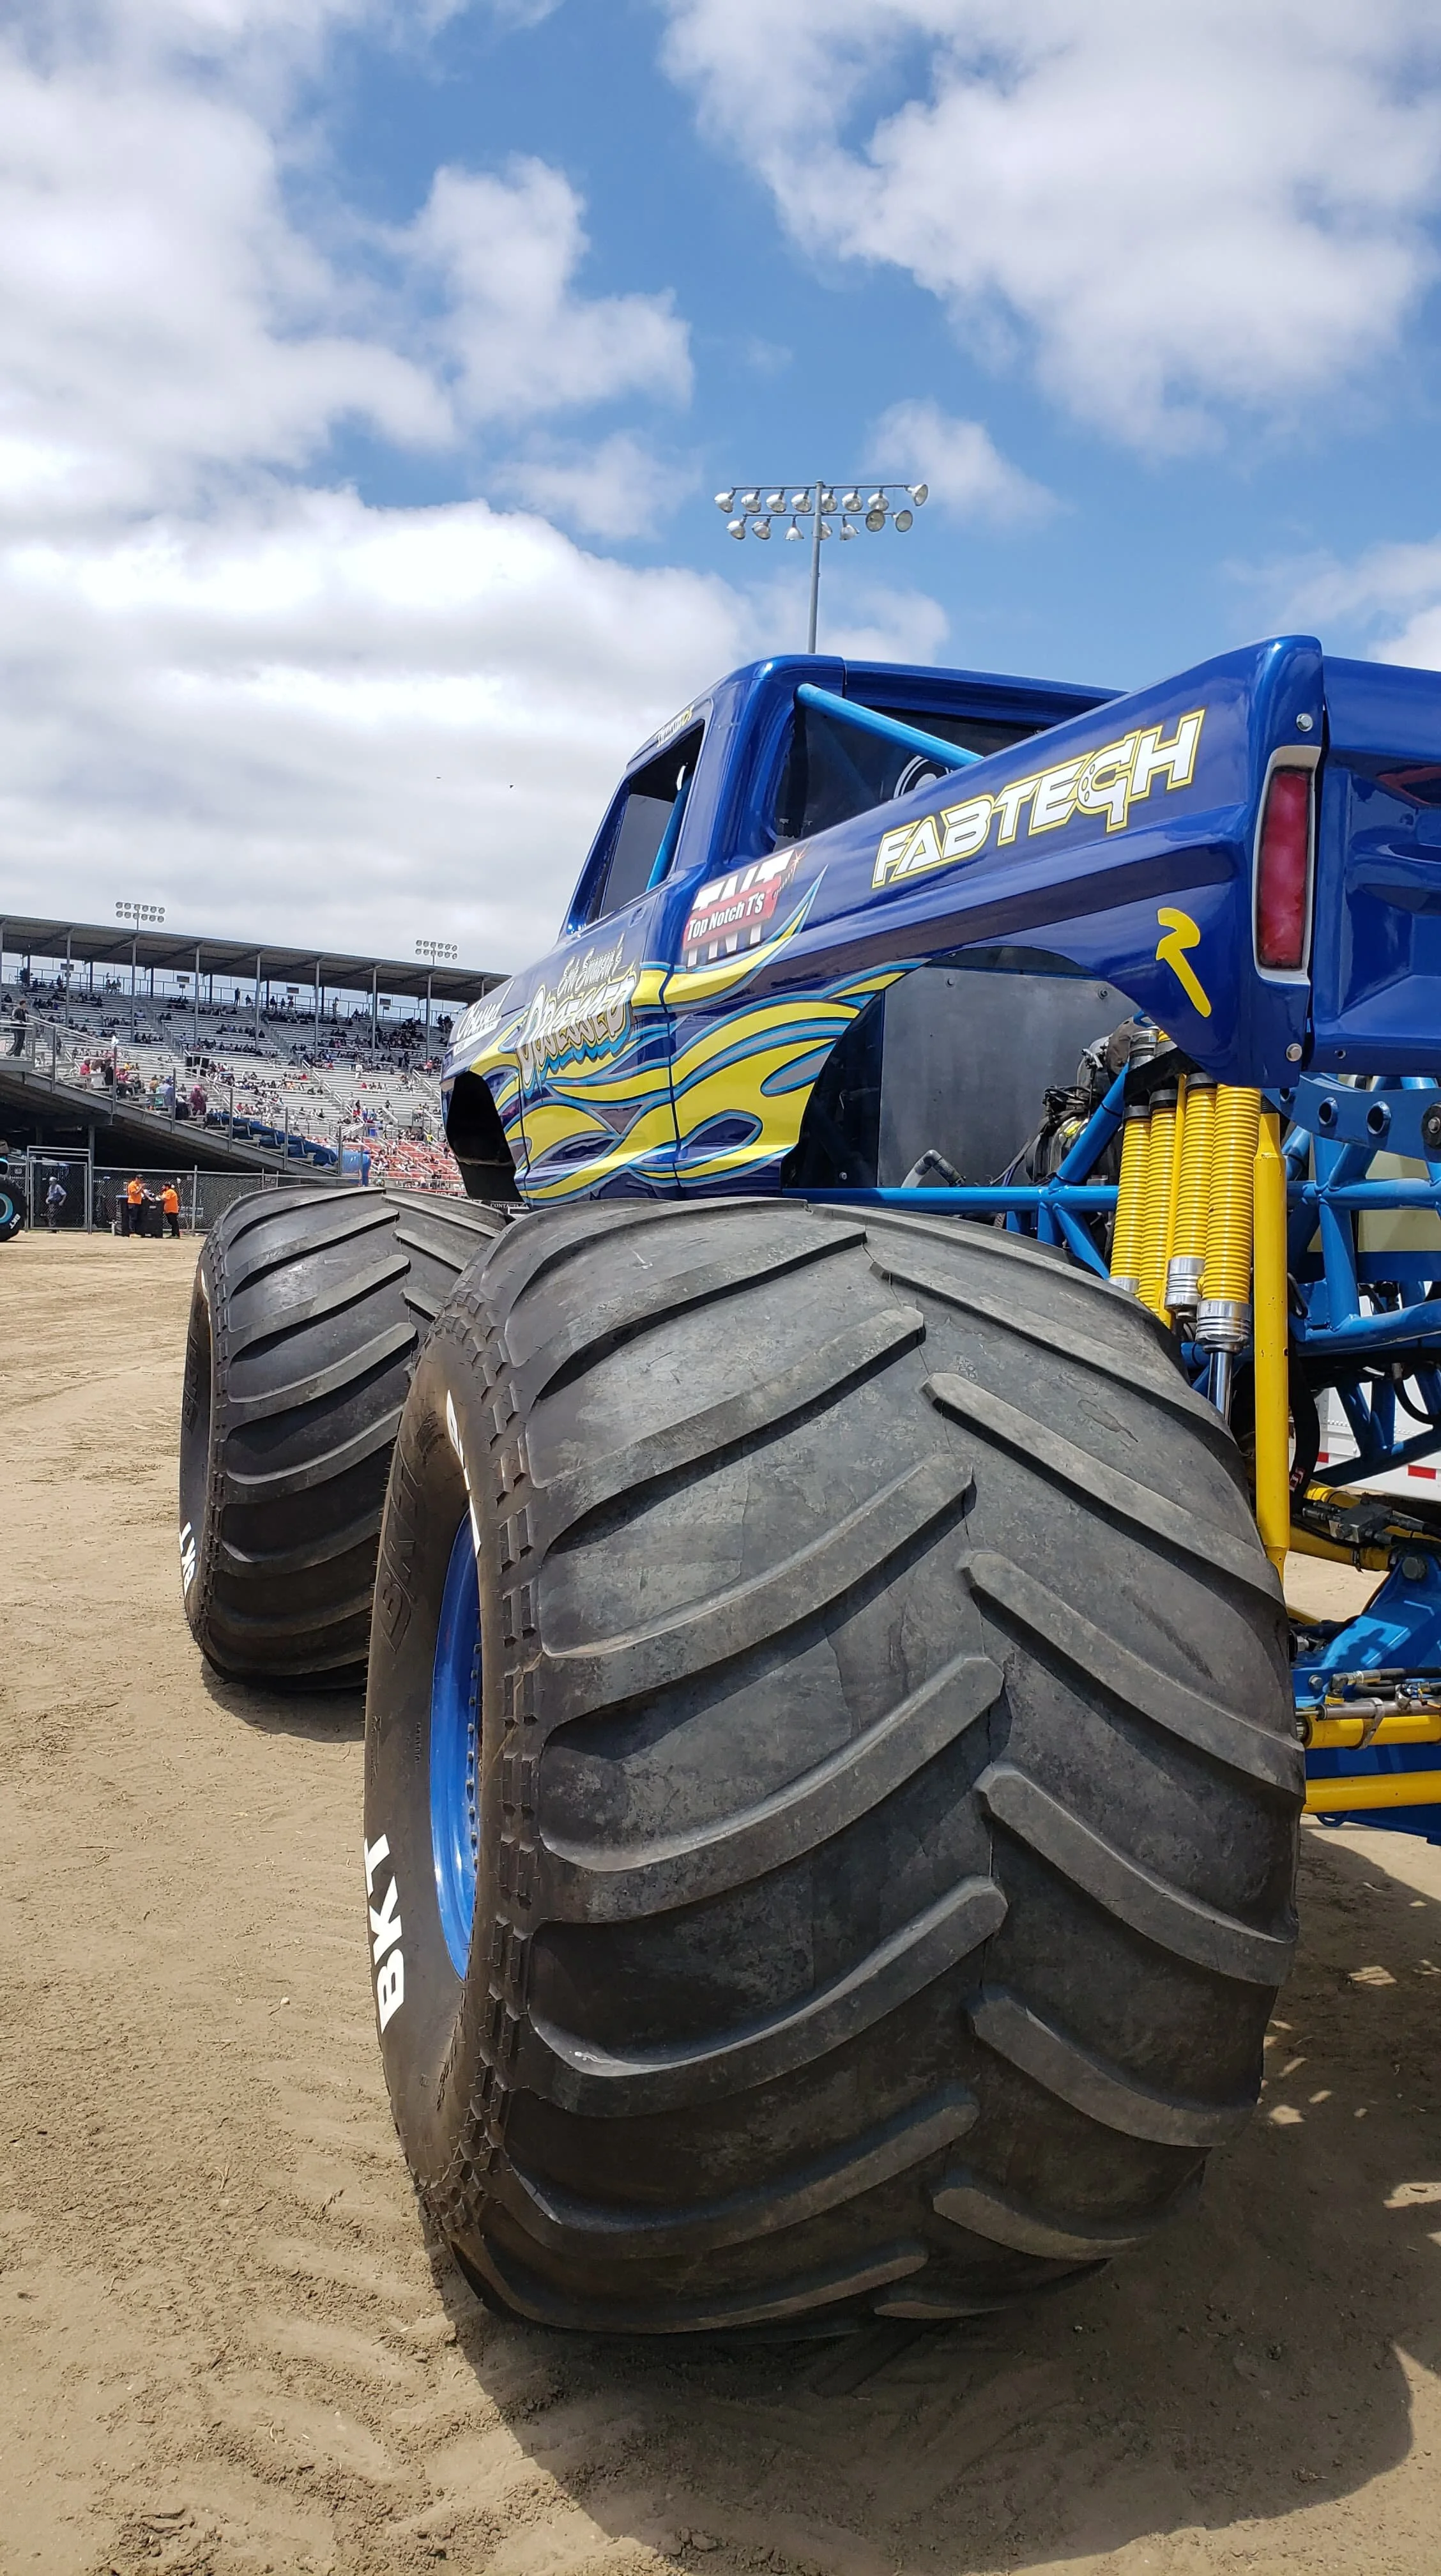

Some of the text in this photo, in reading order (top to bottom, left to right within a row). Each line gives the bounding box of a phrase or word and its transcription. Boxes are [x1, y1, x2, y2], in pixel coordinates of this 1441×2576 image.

[871, 709, 1205, 889] FABTECH
[687, 919, 708, 941] Top
[708, 900, 745, 931] Notch
[364, 1834, 404, 2028] BKT
